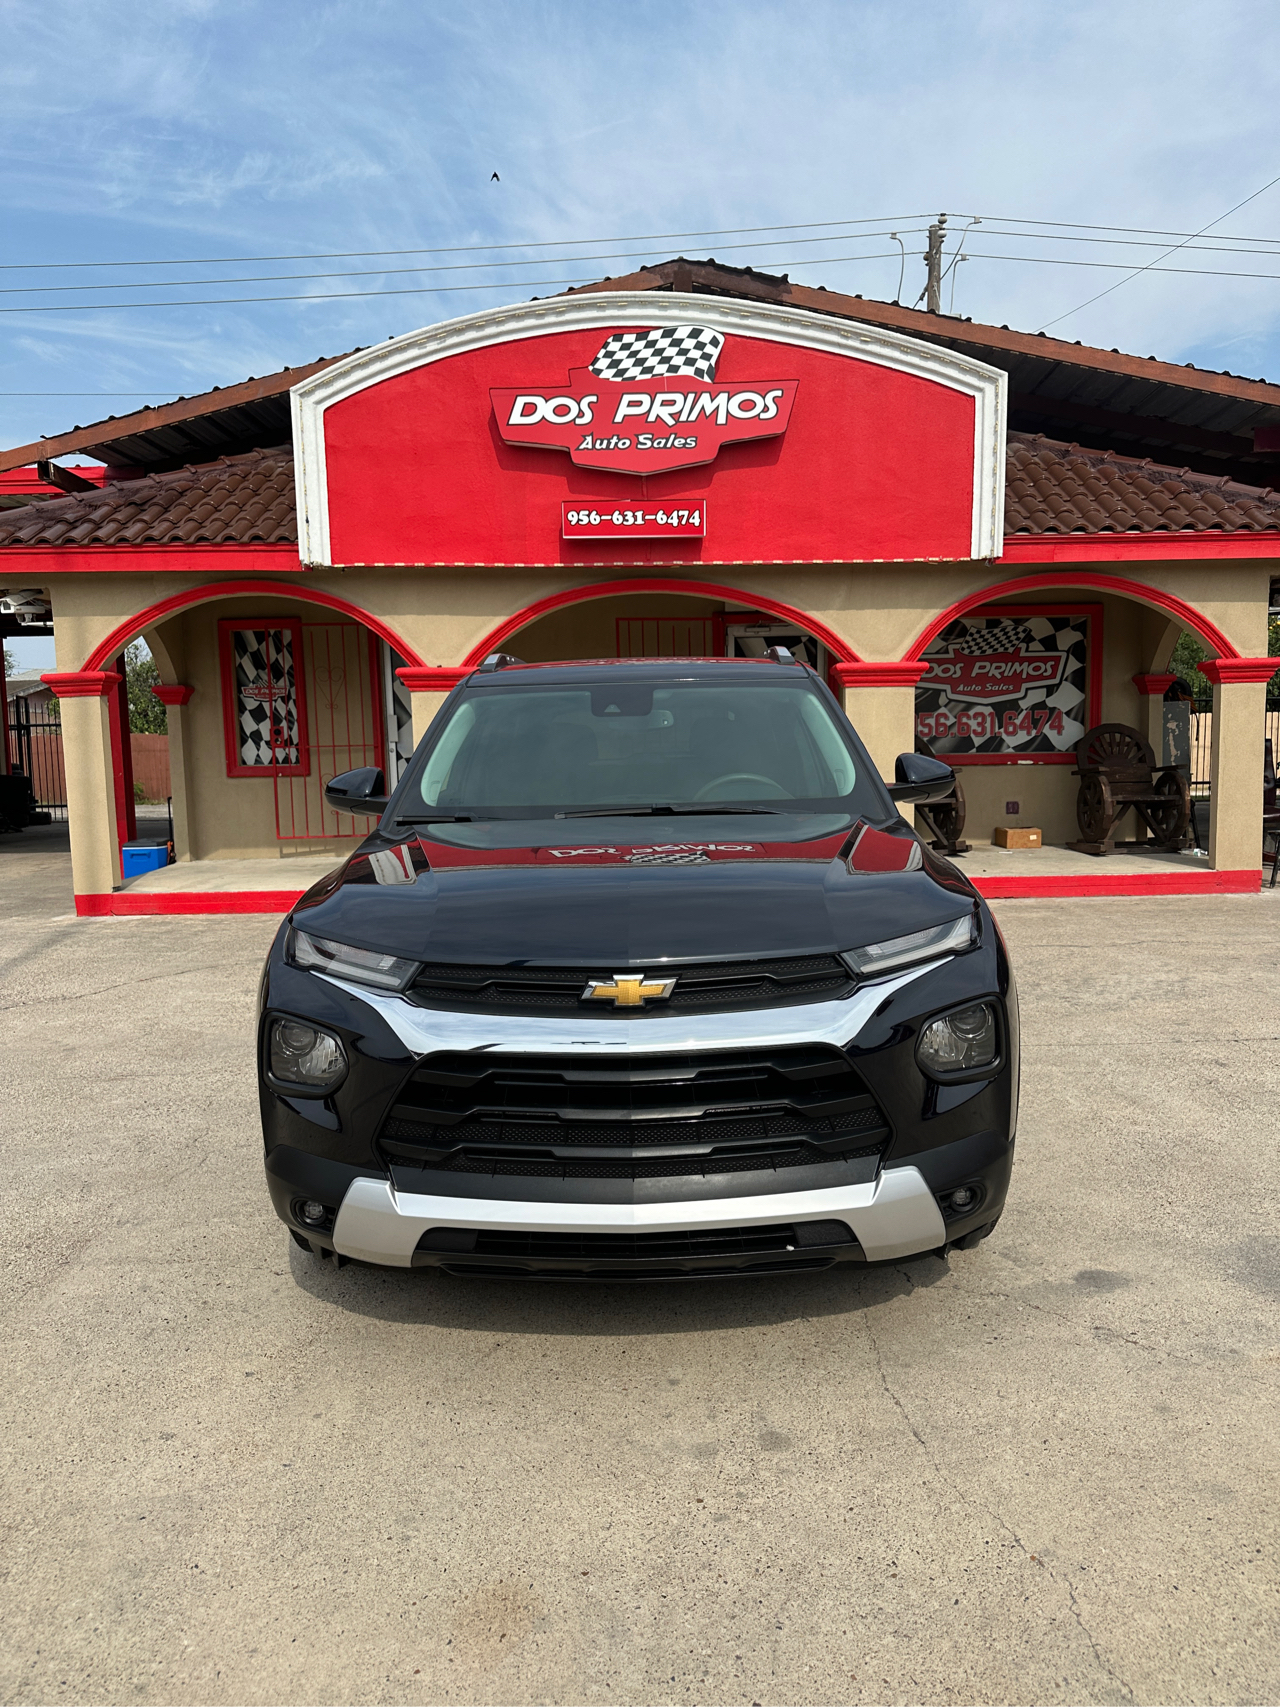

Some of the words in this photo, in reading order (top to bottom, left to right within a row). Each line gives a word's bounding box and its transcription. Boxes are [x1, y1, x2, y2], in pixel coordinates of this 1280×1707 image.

[507, 394, 598, 426] DOS
[612, 389, 784, 427] PRIMOS
[576, 432, 631, 450] Auto
[636, 433, 698, 449] Sales
[567, 509, 701, 527] 956-631-6474
[921, 662, 964, 678] DOS
[971, 661, 1055, 679] PRIMOS
[956, 683, 982, 692] Auto
[985, 682, 1014, 691] Sales
[915, 710, 1065, 738] 56.631.6474
